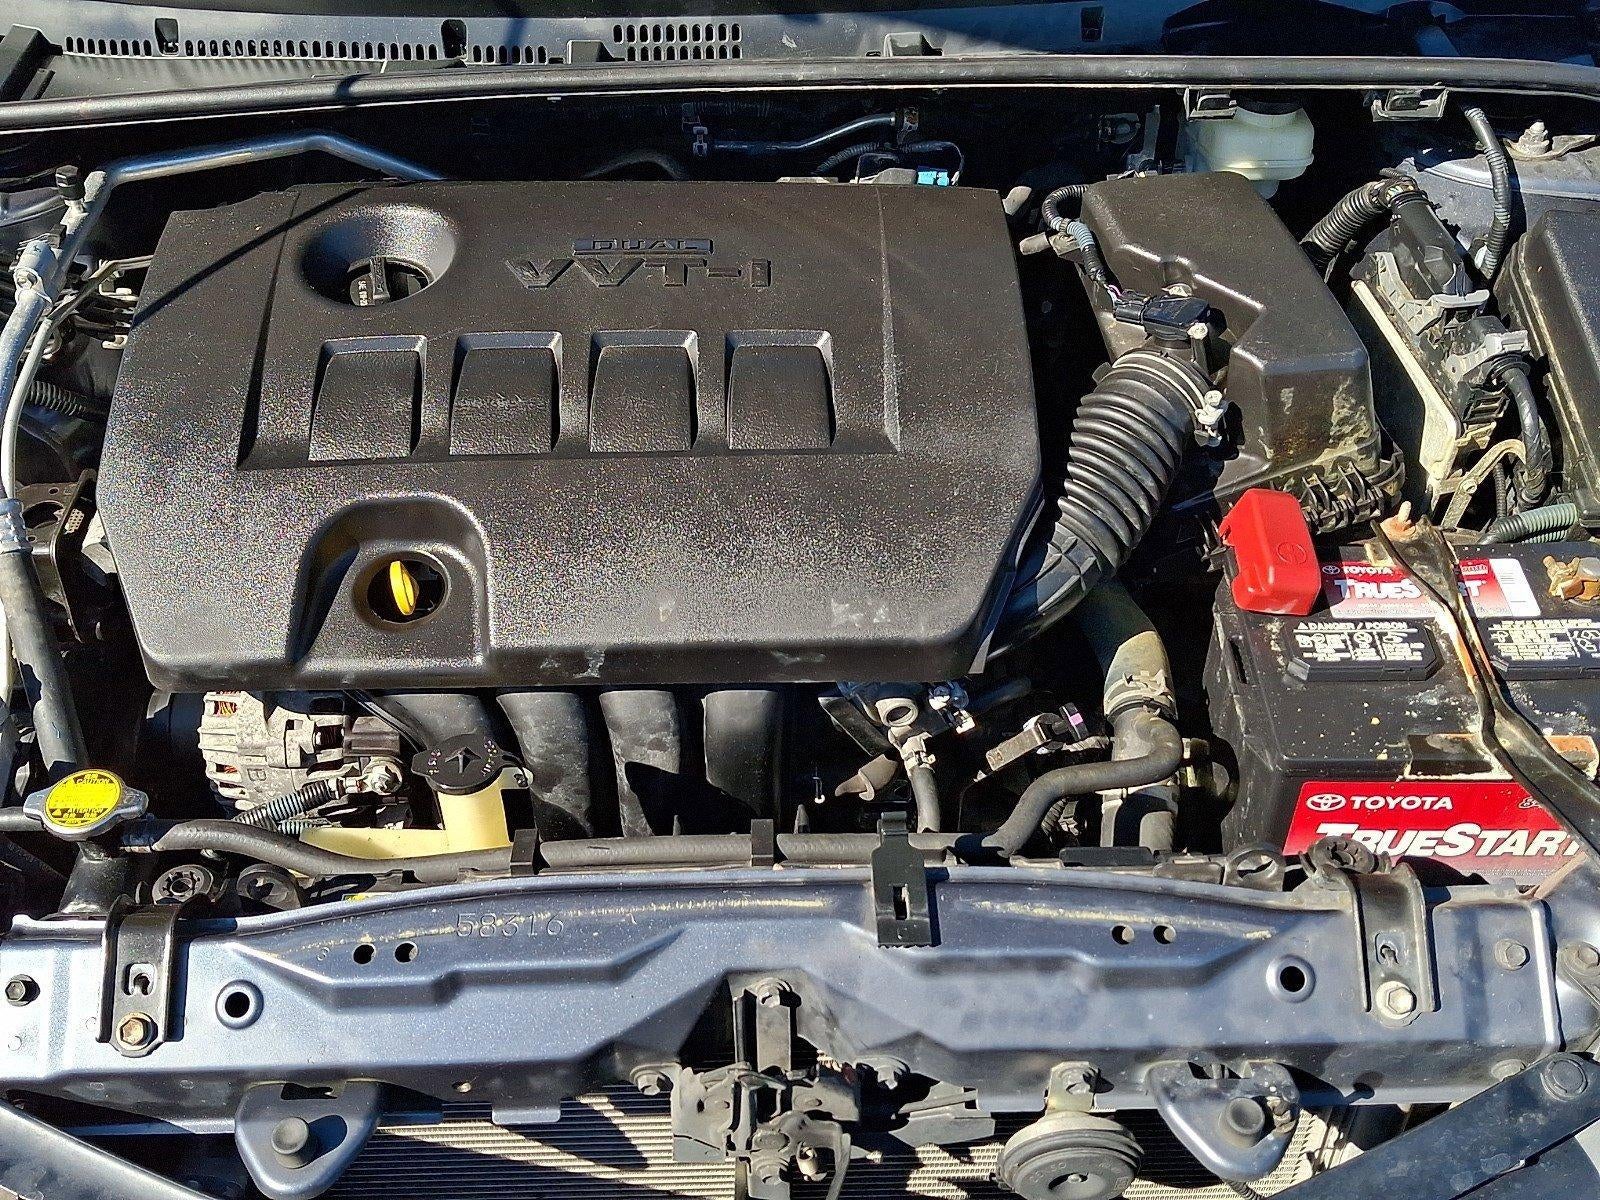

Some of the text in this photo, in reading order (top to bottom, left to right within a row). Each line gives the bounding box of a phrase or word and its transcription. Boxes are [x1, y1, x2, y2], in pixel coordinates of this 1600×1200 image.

[592, 239, 700, 251] DUAL
[1342, 565, 1394, 575] TOYOTA
[1307, 622, 1356, 630] DANGER
[1350, 796, 1453, 811] TOYOTA
[455, 912, 564, 938] 58316
